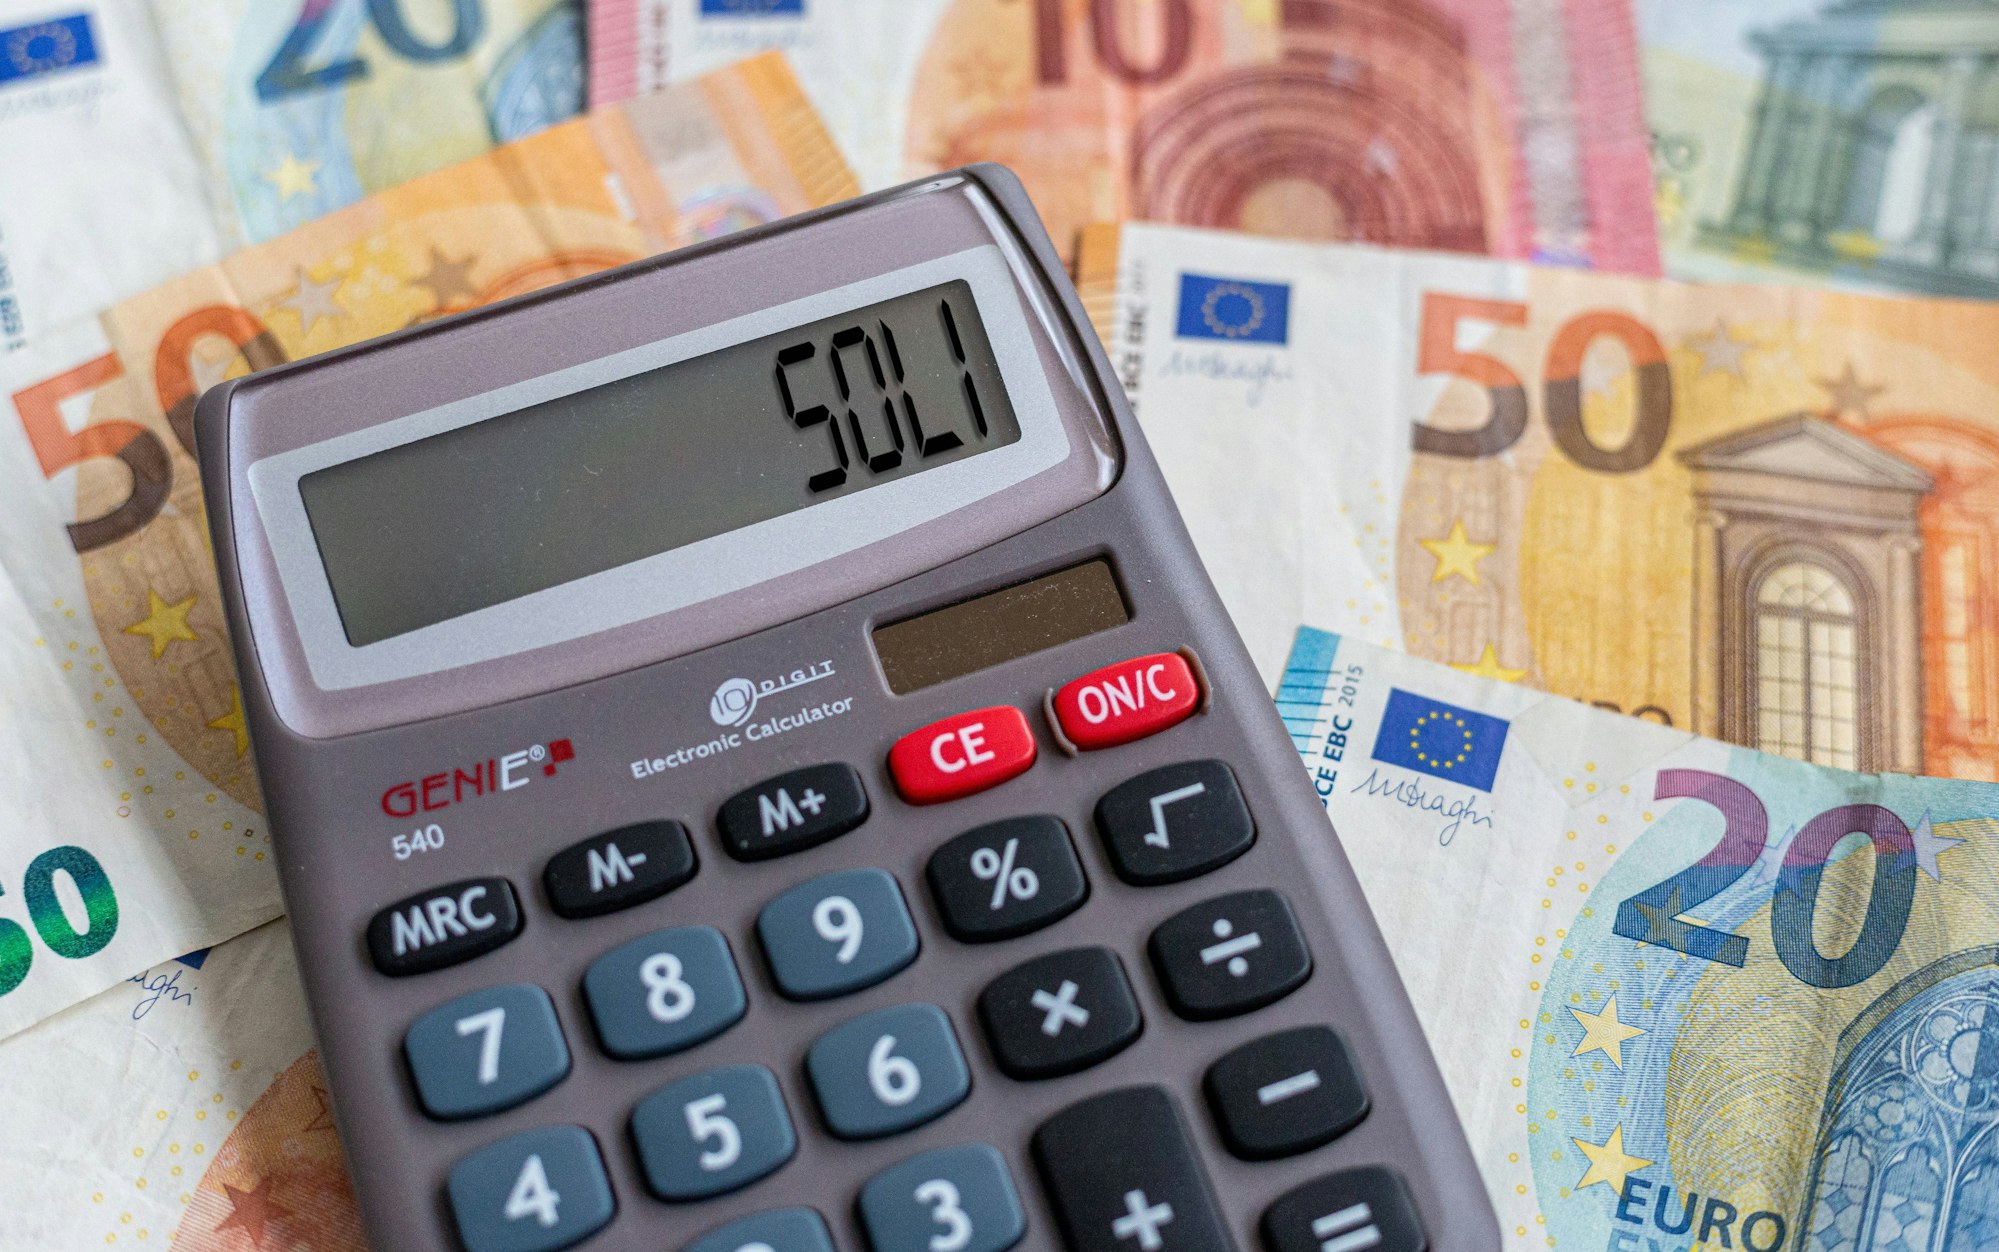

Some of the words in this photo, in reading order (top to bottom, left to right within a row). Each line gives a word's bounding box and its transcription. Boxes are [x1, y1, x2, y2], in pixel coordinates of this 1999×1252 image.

[1411, 290, 1675, 476] 50
[12, 301, 289, 554] 50
[759, 659, 834, 694] DIGIT
[1077, 663, 1177, 724] ON/C
[1337, 663, 1364, 708] 2015
[630, 733, 742, 780] Electronic
[745, 696, 854, 742] Calculator
[931, 722, 995, 773] CE
[1322, 714, 1353, 763] EBC
[391, 823, 446, 861] 540
[758, 787, 826, 837] M+
[588, 843, 647, 892] M-
[970, 837, 1039, 909] %
[1612, 767, 1918, 989] 20
[392, 885, 496, 956] MRC
[813, 895, 864, 964] 9
[639, 952, 696, 1021] 8
[456, 1006, 506, 1083] 7
[867, 1034, 921, 1104] 6
[684, 1092, 742, 1170] 5
[502, 1154, 561, 1226] 4
[914, 1178, 973, 1252] 3
[1615, 1174, 1787, 1252] EURO
